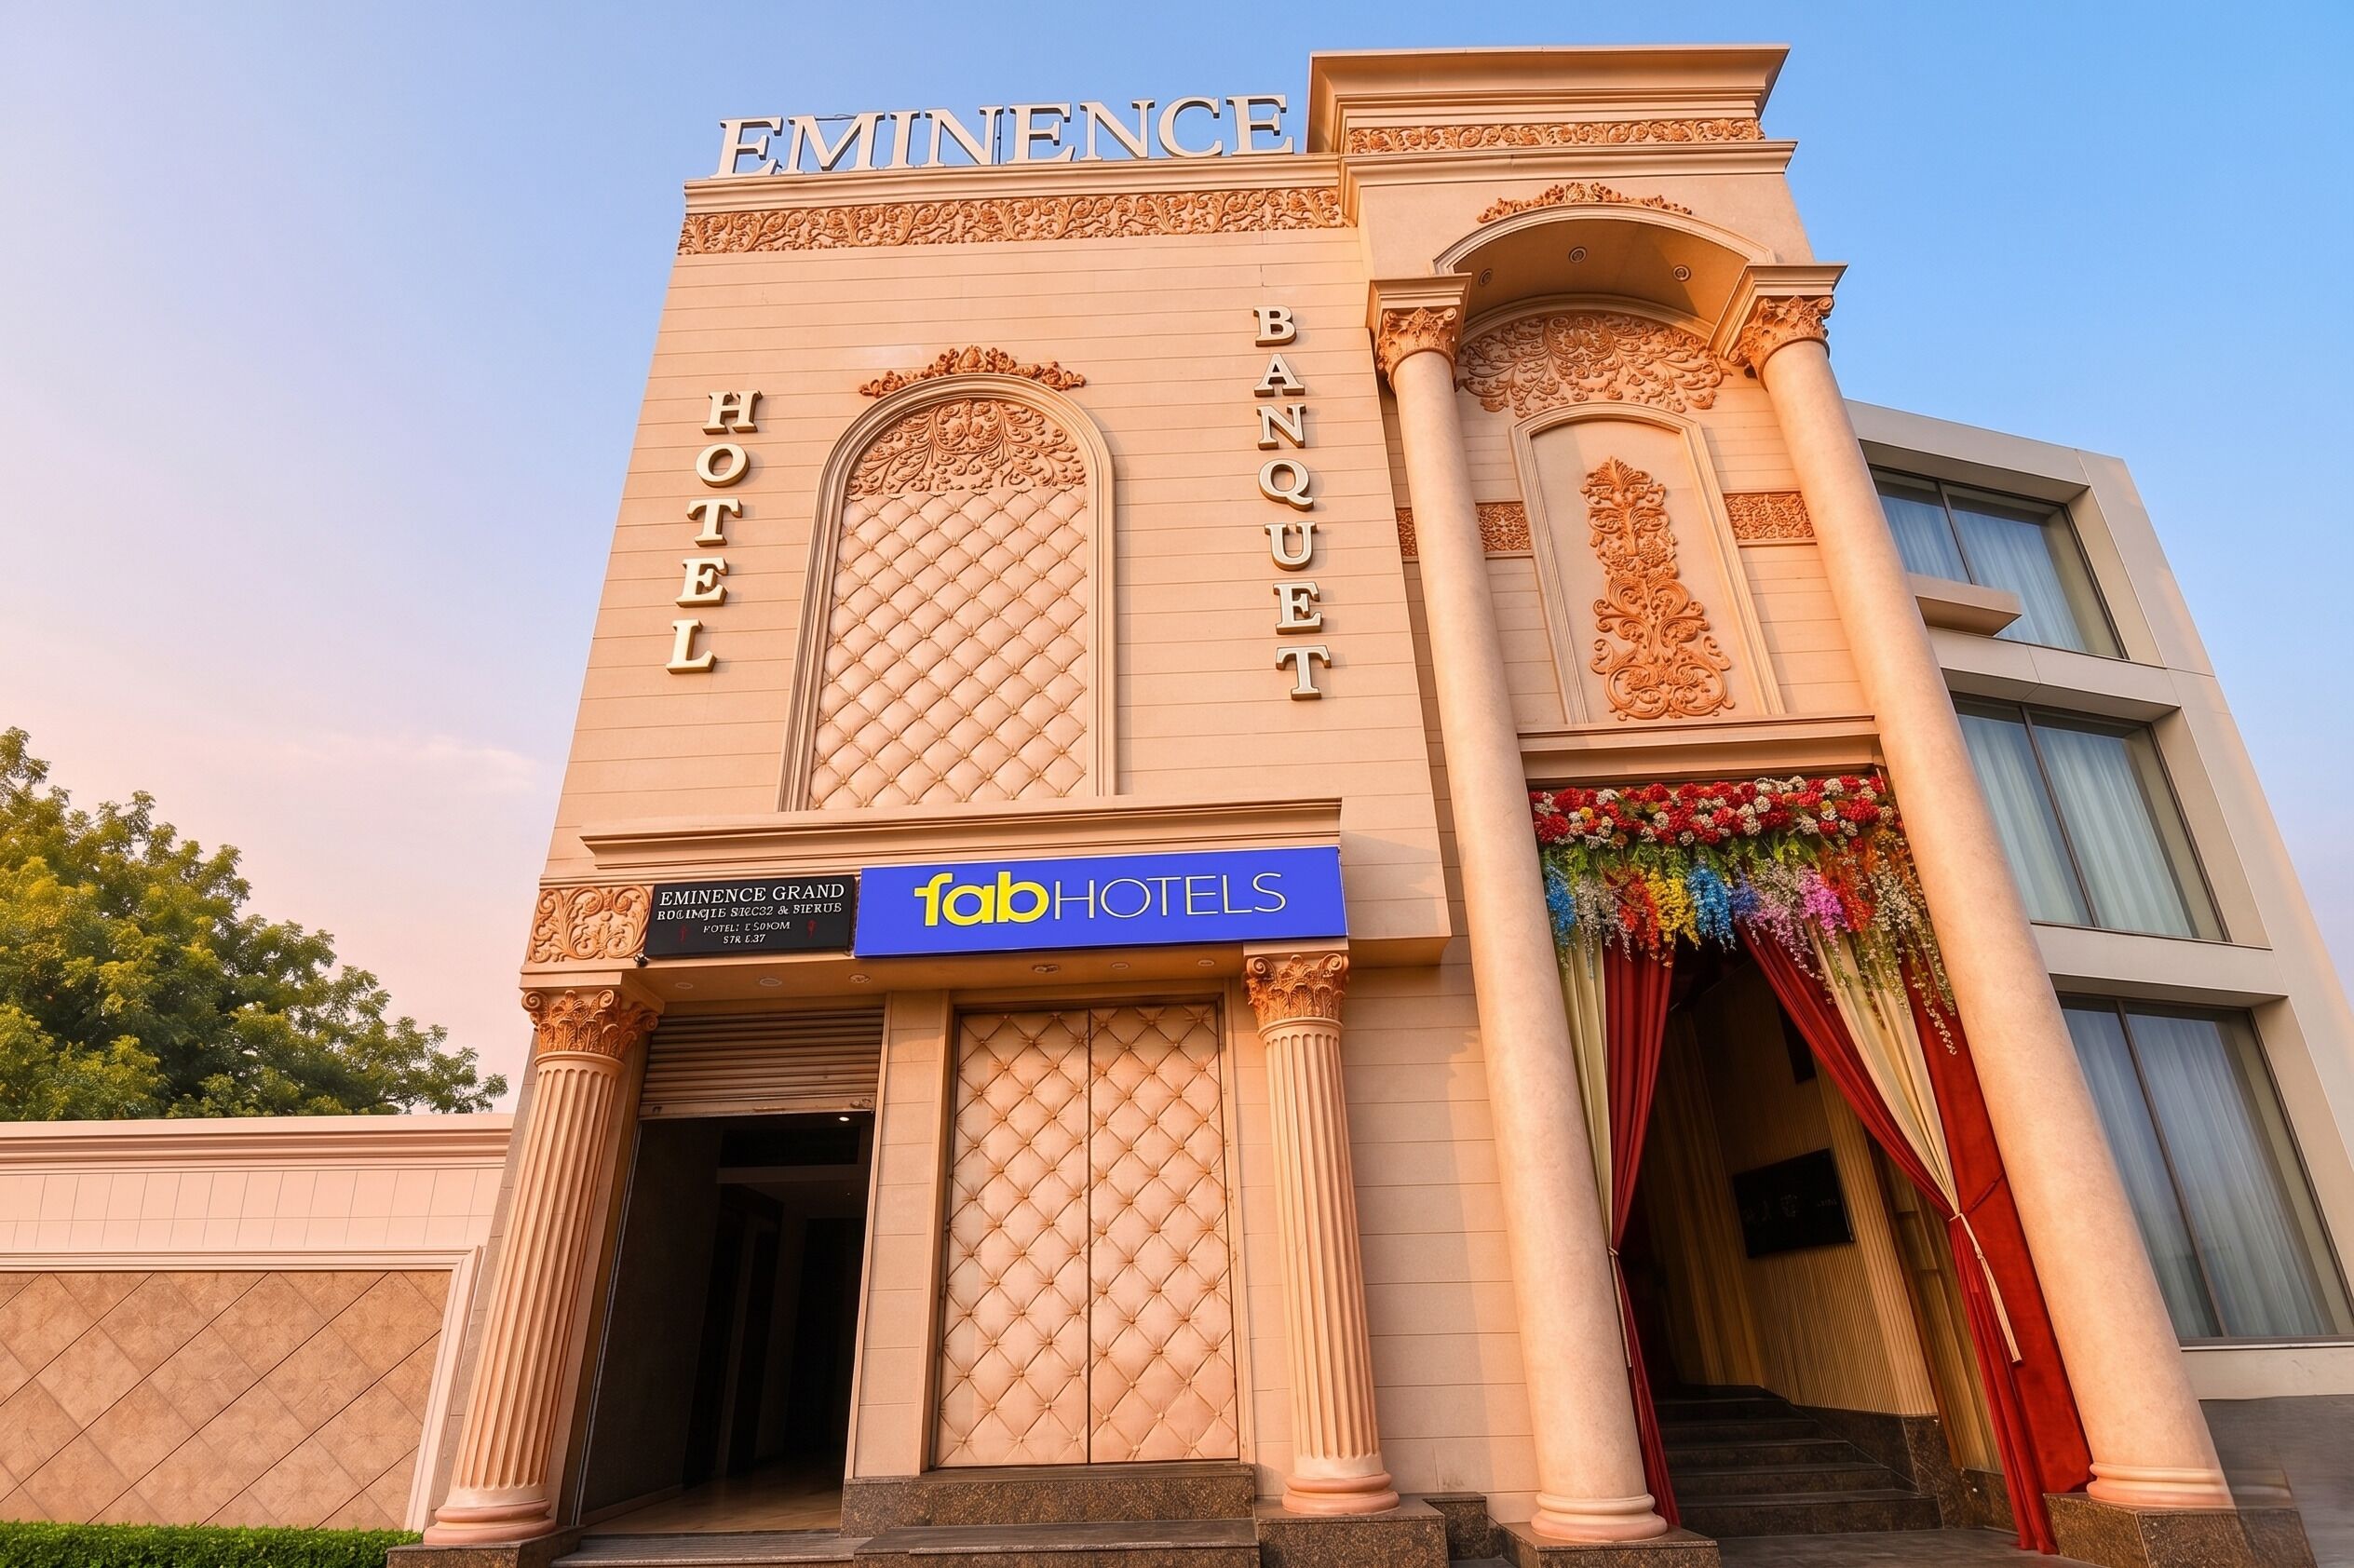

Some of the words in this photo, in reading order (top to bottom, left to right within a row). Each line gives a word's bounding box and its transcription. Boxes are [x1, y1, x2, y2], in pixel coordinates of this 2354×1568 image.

[709, 94, 1295, 180] EMINENCE
[666, 390, 763, 674] HOTEL
[1253, 304, 1332, 700] BANQUET
[659, 887, 766, 906] EMINENCE
[772, 884, 845, 900] GRAND
